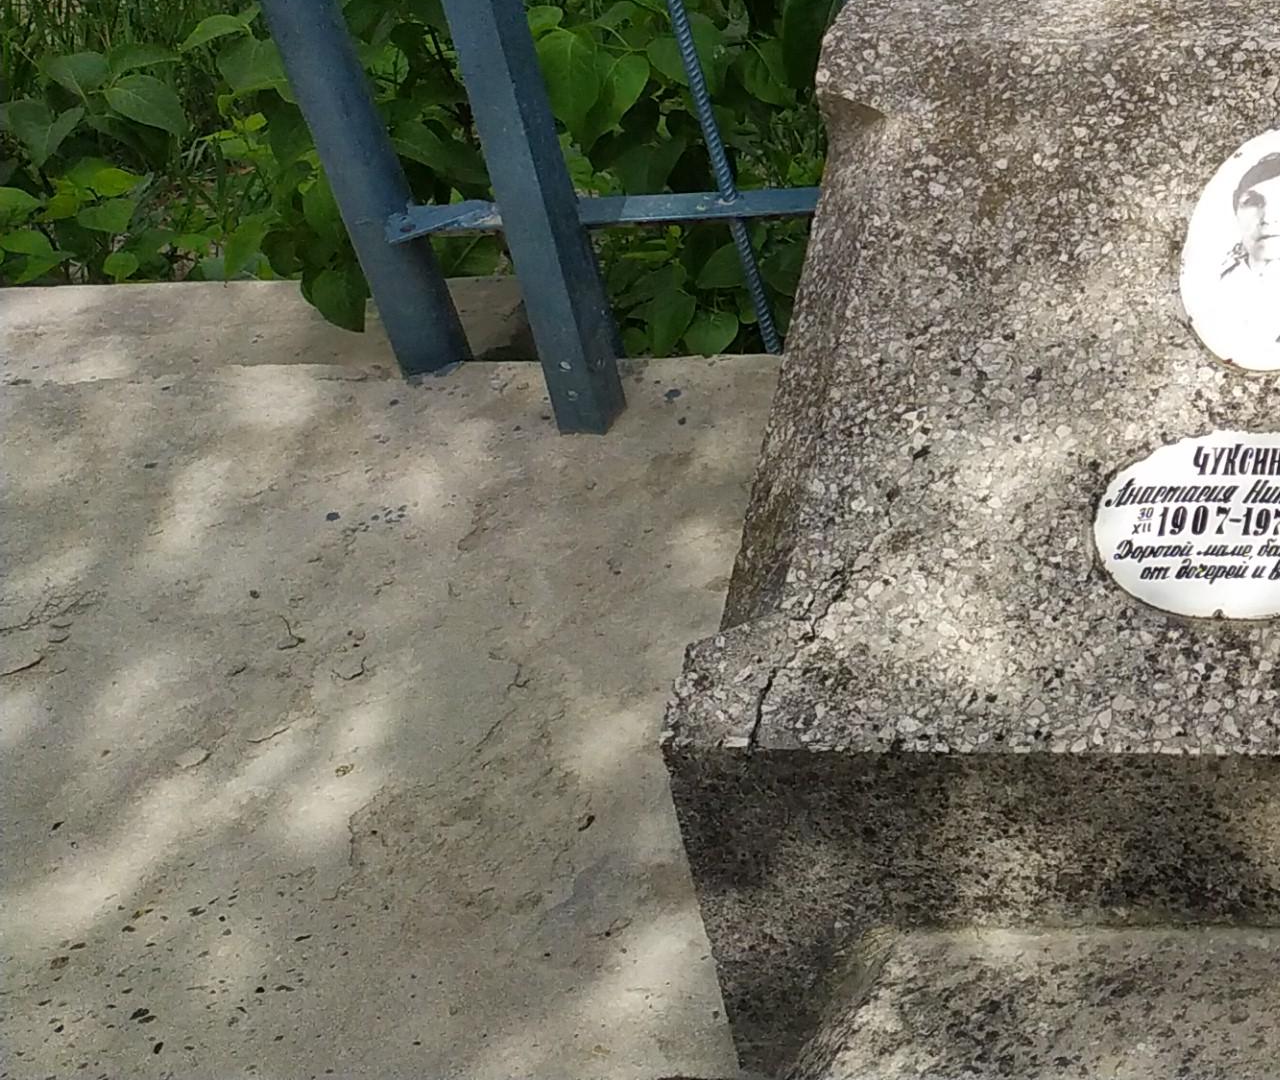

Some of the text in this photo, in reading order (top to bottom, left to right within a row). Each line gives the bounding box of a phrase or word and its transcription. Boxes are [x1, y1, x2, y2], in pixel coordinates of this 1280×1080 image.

[1104, 478, 1240, 508] Анастасия
[1113, 539, 1193, 564] Дорогой
[1174, 557, 1249, 585] дочерей
